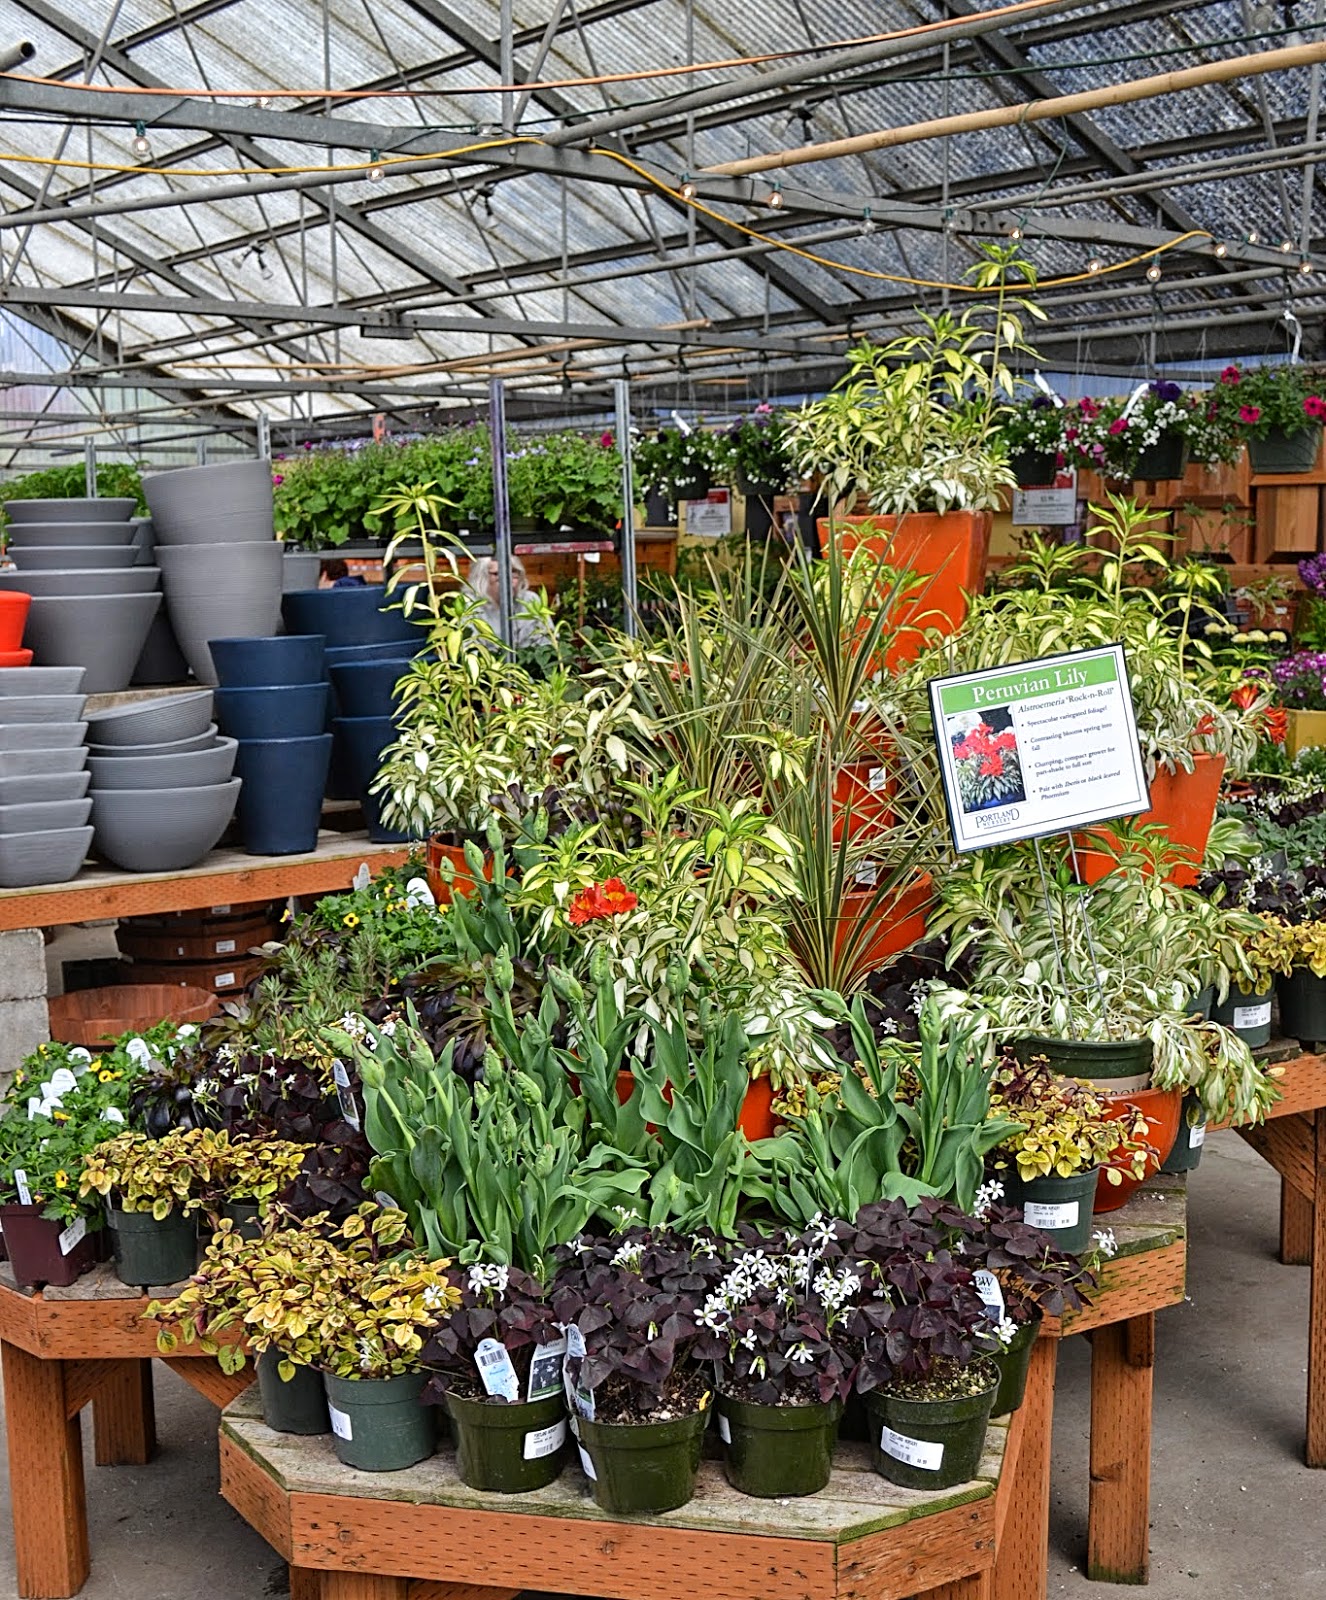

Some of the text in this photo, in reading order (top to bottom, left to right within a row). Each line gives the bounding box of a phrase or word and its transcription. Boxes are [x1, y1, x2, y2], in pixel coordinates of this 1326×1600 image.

[972, 667, 1088, 704] Peruvian Lily
[1018, 697, 1065, 713] Alstroemeria
[1027, 715, 1059, 727] Spectacular
[1060, 709, 1087, 720] variegated
[1030, 732, 1062, 744] Contrasting
[1063, 728, 1083, 737] blooms
[1083, 725, 1101, 734] spring
[1065, 753, 1087, 763] compact
[1088, 749, 1107, 758] grower
[1039, 785, 1050, 793] Pair
[1051, 782, 1063, 790] with
[1088, 774, 1102, 783] black
[1103, 770, 1121, 779] leaved
[975, 807, 1020, 828] PORTLAND
